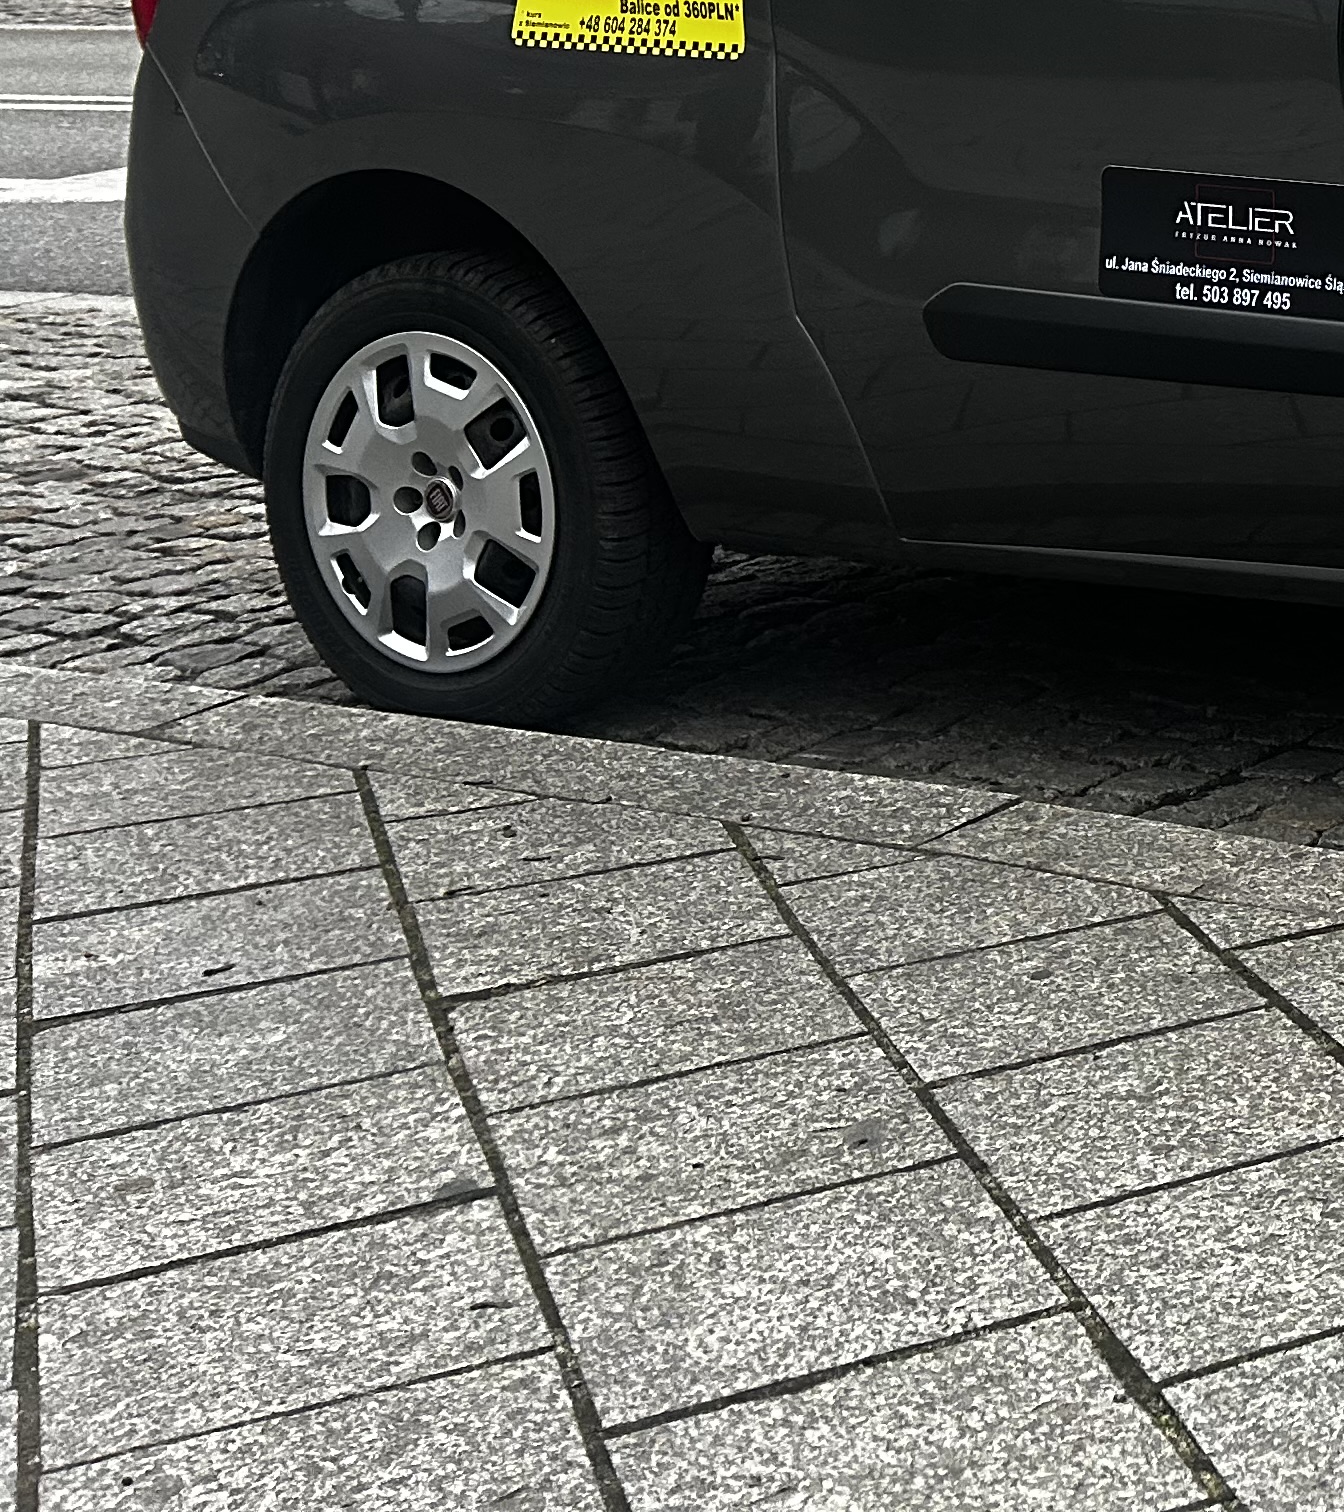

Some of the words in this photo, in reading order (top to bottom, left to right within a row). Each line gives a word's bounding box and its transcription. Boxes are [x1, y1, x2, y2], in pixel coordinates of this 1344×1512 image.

[664, 0, 680, 17] od
[579, 14, 600, 33] +48
[603, 16, 626, 34] 604
[629, 18, 651, 36] 284
[654, 19, 677, 38] 374
[1175, 200, 1295, 235] ATELIER
[1222, 235, 1252, 245] ANNA
[1258, 239, 1298, 249] NOWAK
[1105, 255, 1120, 270] ul.
[1121, 256, 1149, 273] Jana
[1150, 256, 1227, 283] Śniadeckiego
[1228, 267, 1240, 284] 2,
[1242, 268, 1322, 289] Siemianowice
[1175, 282, 1198, 301] tel.
[1202, 284, 1229, 304] 503
[1232, 287, 1260, 307] 897
[1262, 290, 1291, 310] 495
